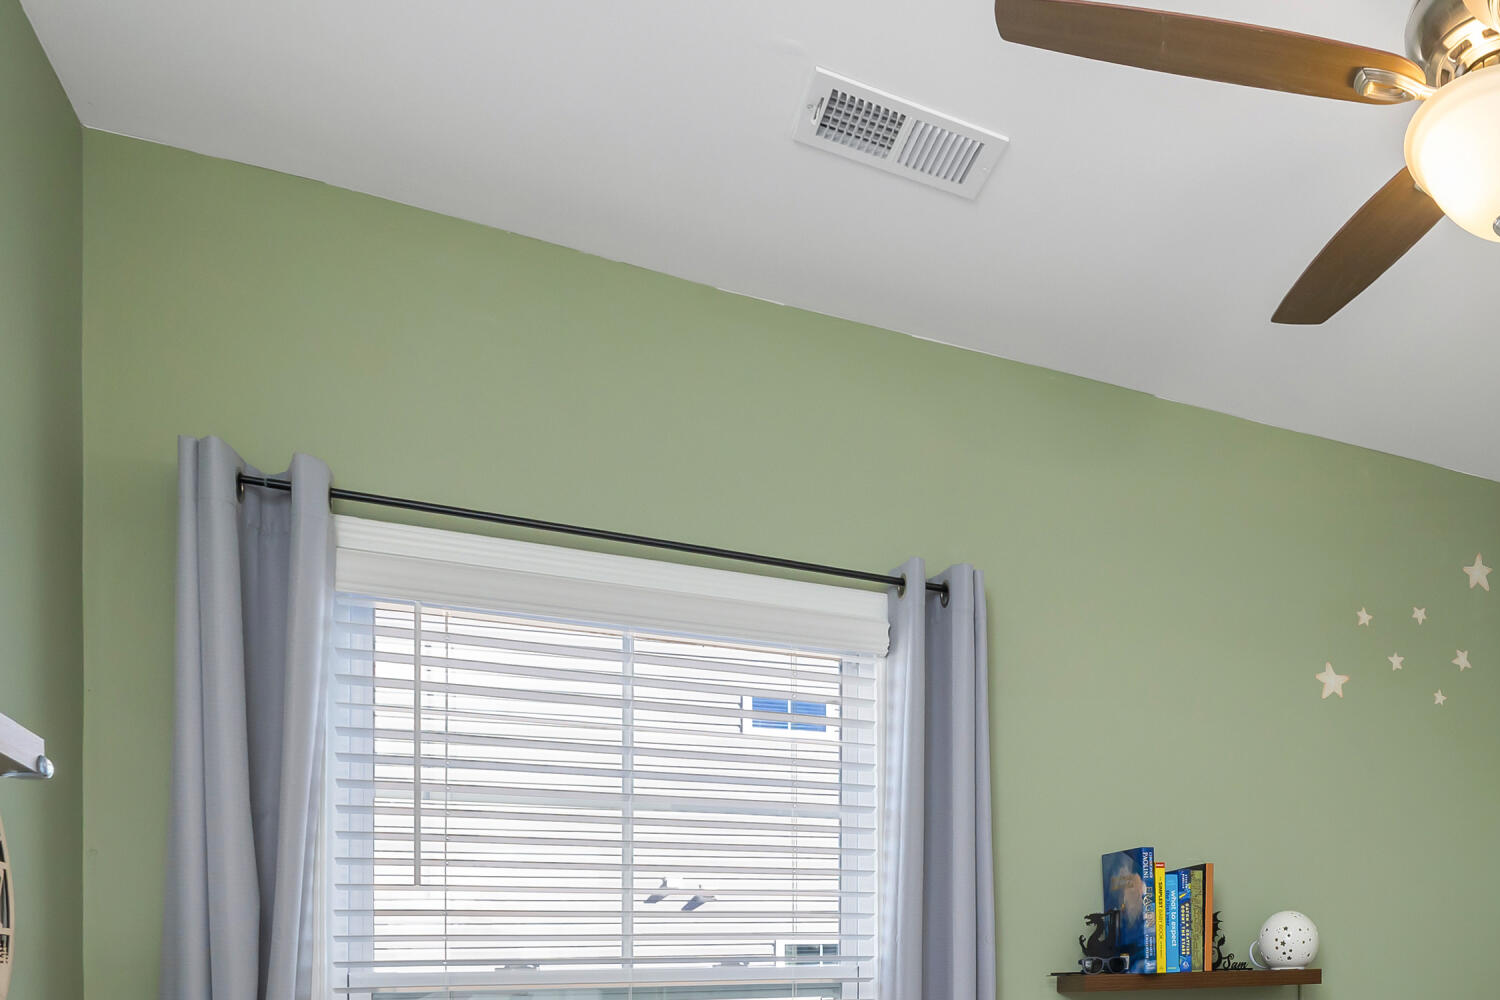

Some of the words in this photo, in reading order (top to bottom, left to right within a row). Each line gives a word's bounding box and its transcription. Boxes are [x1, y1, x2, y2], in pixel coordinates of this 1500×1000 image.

[1144, 886, 1153, 929] ERAGON
[1171, 911, 1177, 920] to
[1223, 953, 1248, 969] Sam
